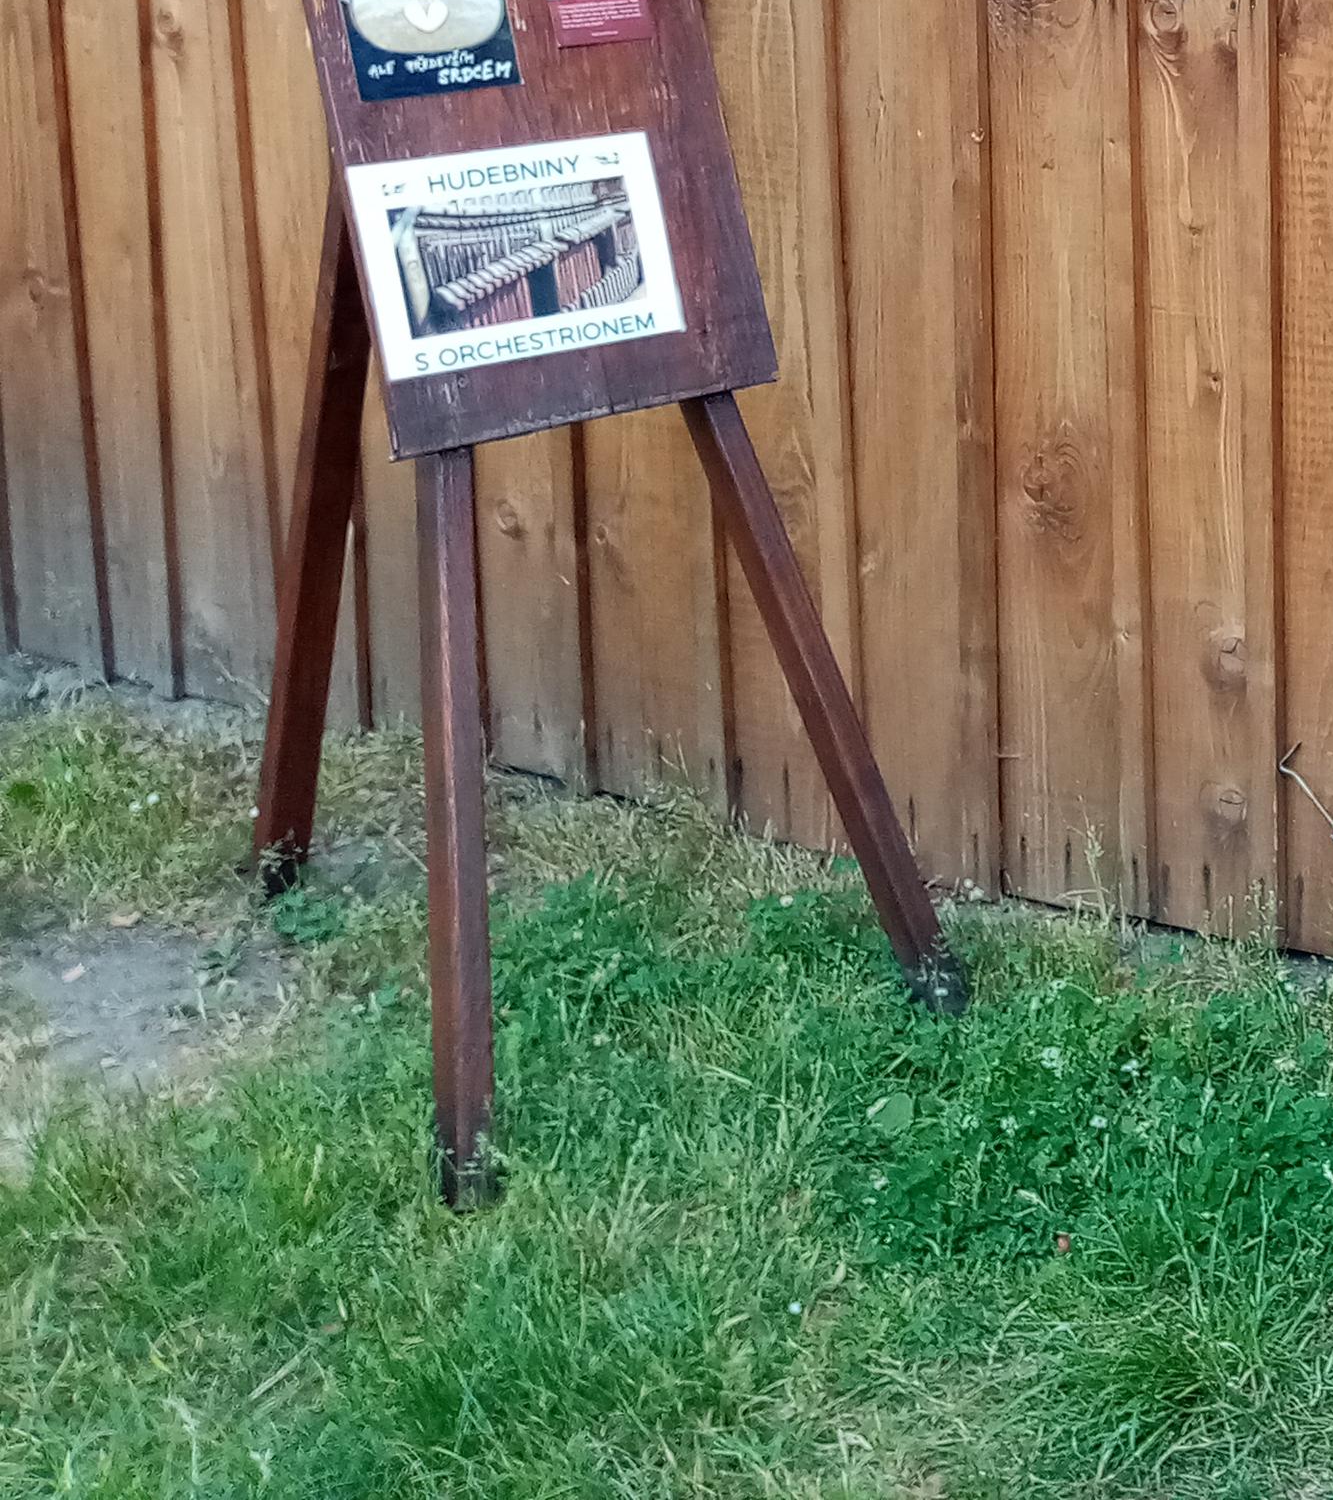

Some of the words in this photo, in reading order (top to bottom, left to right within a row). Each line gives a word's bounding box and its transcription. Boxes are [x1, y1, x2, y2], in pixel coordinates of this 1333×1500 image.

[437, 59, 512, 85] SRDCEM
[427, 155, 581, 195] HUDEBNINY
[414, 352, 430, 372] S
[438, 312, 656, 367] ORCHESTRIONEM
